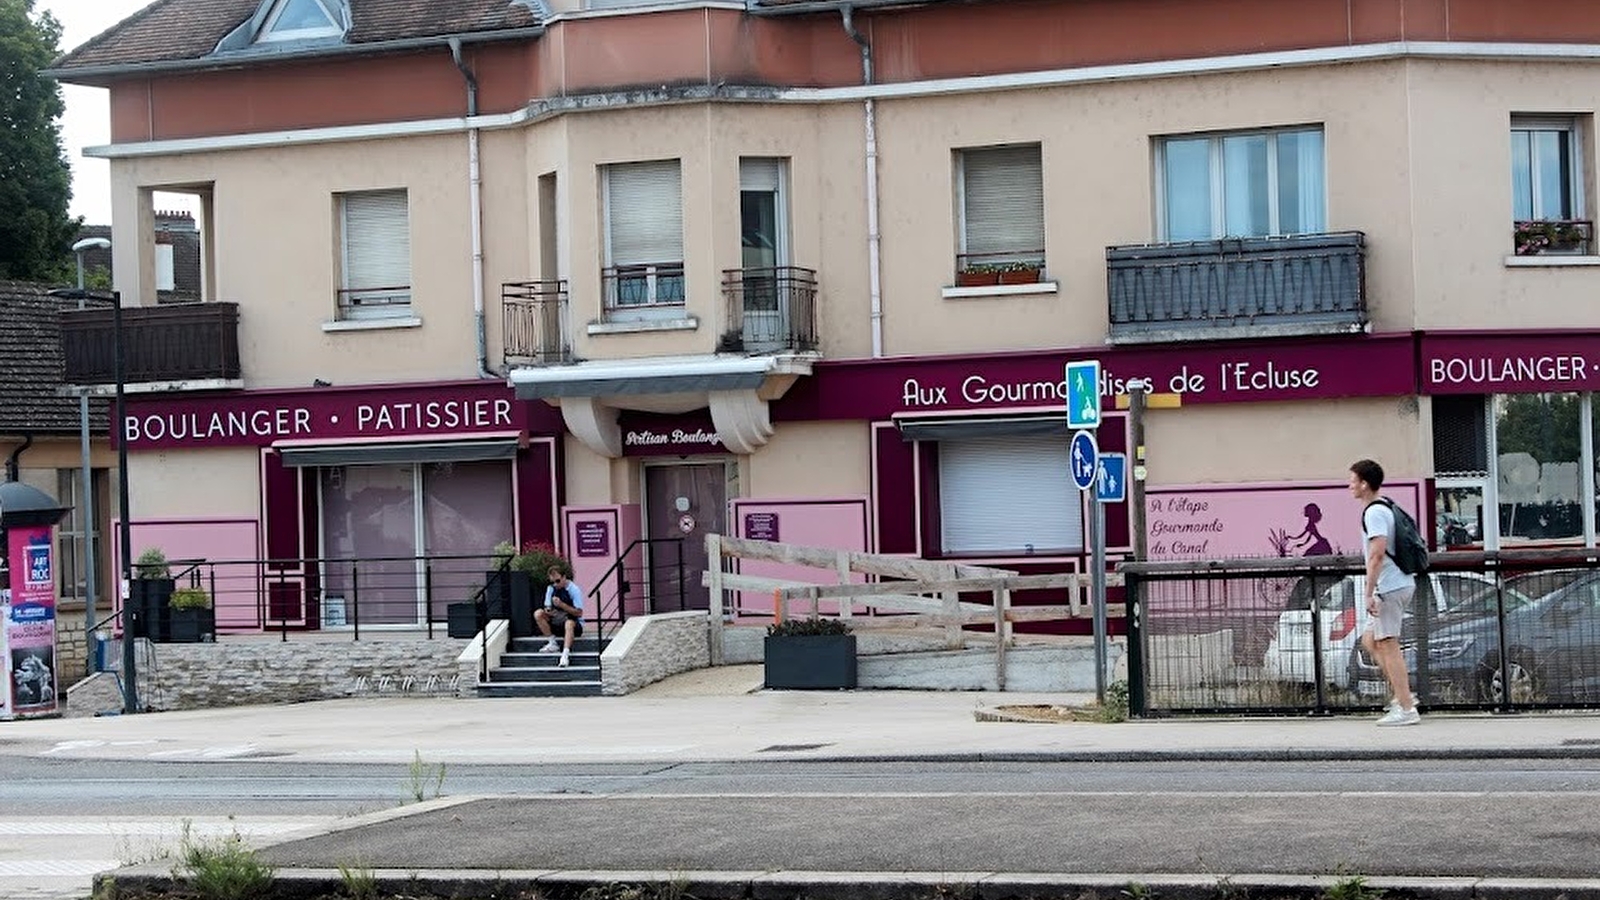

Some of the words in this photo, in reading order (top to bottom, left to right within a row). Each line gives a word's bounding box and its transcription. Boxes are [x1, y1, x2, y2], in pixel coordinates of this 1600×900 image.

[1431, 356, 1587, 383] BOULANGER
[903, 378, 947, 406] Aux
[1169, 366, 1205, 394] de
[1221, 361, 1319, 391] l'Ecluse
[125, 408, 311, 441] BOULANGER
[357, 400, 511, 431] PATISSIER
[625, 430, 669, 446] Artisan
[1150, 499, 1162, 513] A
[1150, 518, 1224, 537] Gourmande
[1150, 541, 1167, 554] du
[1171, 539, 1209, 555] Canal
